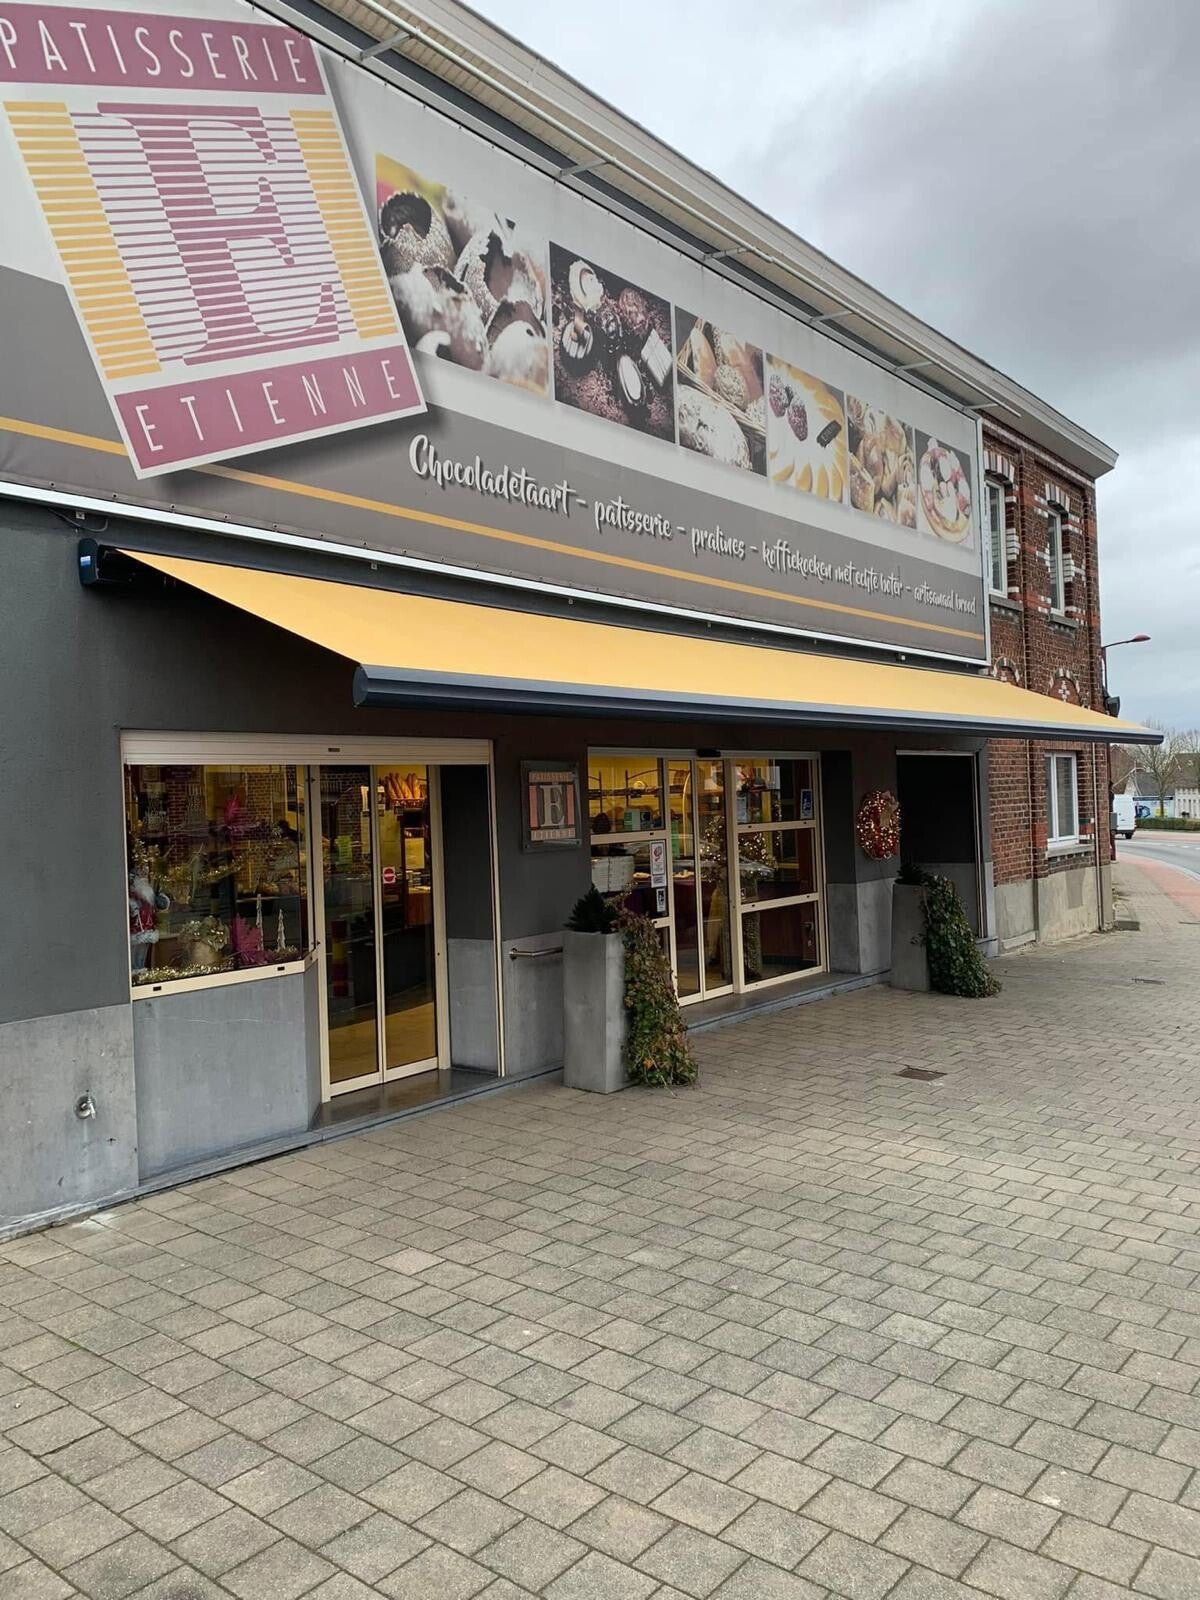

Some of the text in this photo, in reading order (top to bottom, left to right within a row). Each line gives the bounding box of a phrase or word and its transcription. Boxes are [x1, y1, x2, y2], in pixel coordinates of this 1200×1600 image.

[0, 18, 306, 83] PATISSERIE
[135, 359, 401, 452] ETIENNE
[409, 434, 577, 514] Chocoladetaart
[594, 495, 672, 537] patisserie
[691, 524, 746, 559] pralines
[762, 538, 832, 581] koffiekoeken
[835, 560, 857, 585] met
[880, 572, 903, 596] boter
